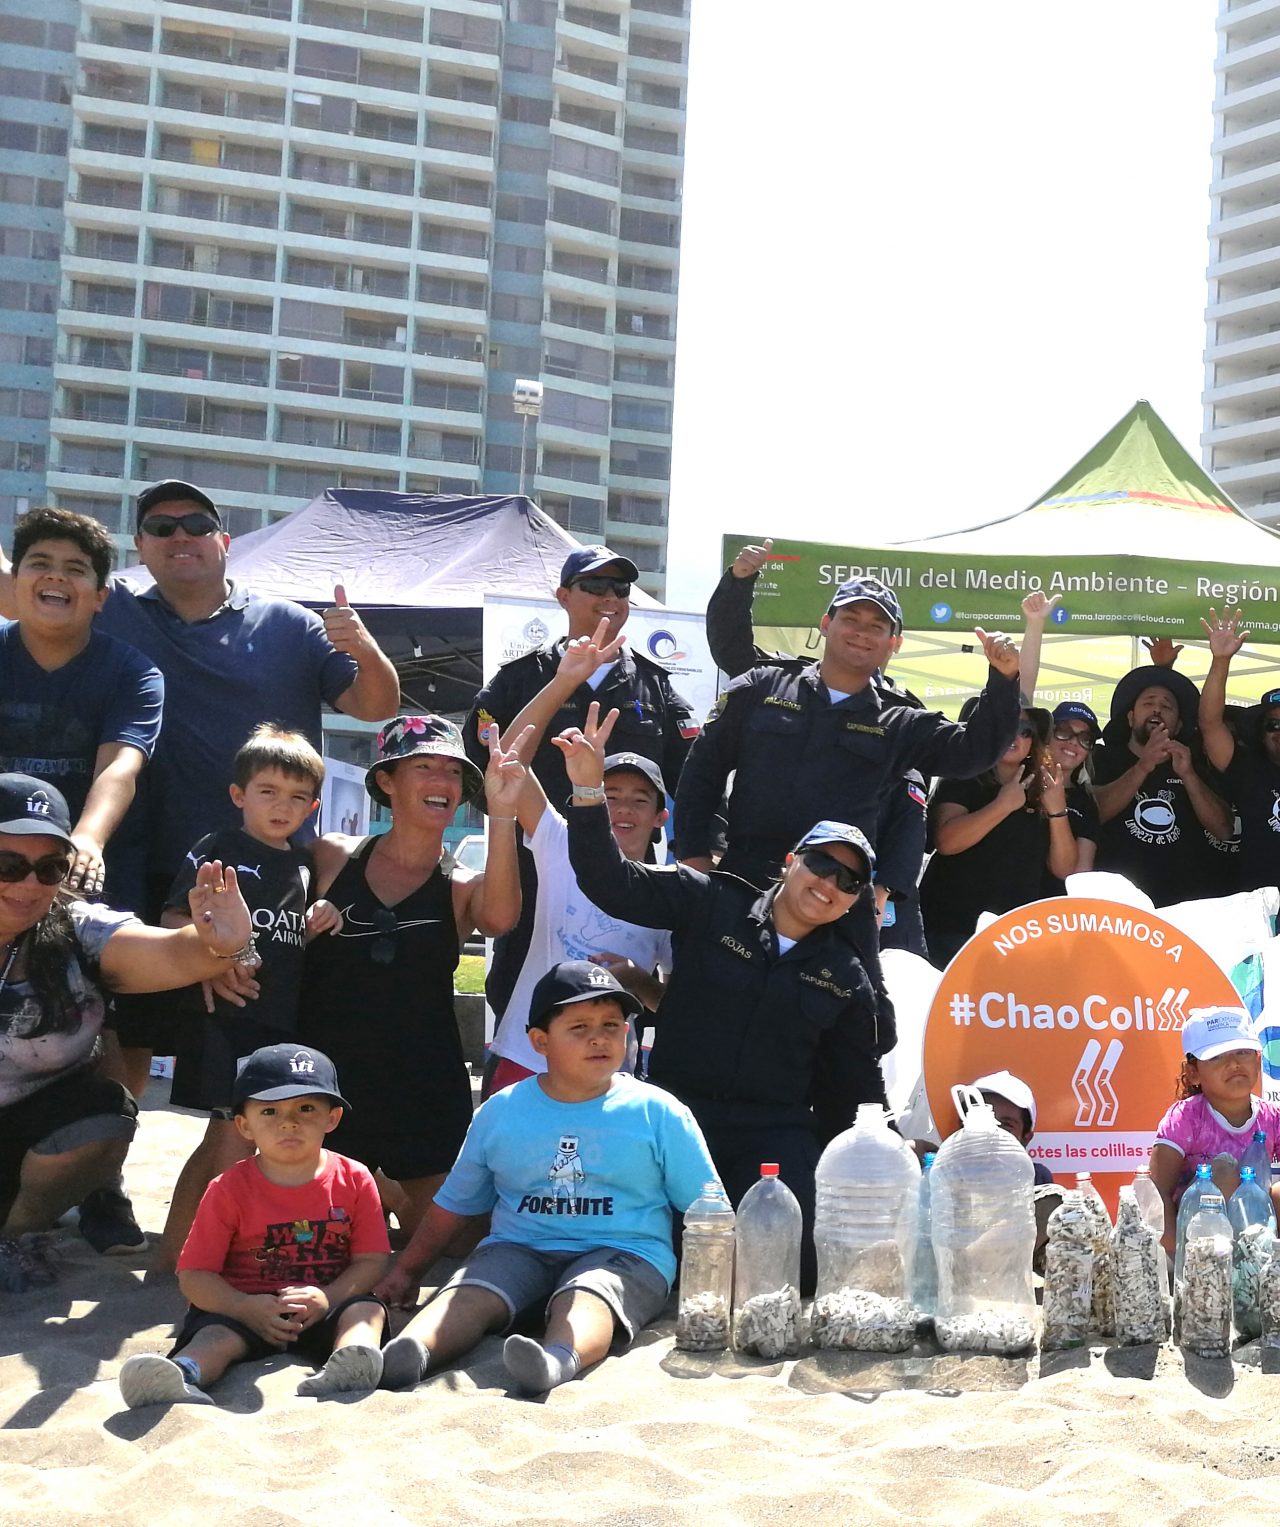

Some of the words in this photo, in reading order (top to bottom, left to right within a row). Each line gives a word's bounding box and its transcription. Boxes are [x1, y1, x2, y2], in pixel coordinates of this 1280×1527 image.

[818, 564, 911, 588] SEREMI
[919, 567, 957, 589] del
[965, 569, 1042, 591] Medio
[1050, 571, 1168, 595] Ambiente
[1196, 577, 1277, 605] Región
[251, 908, 307, 932] QATA
[720, 935, 753, 959] ROJAS
[993, 918, 1043, 956] NOS
[1046, 913, 1166, 949] SUMAMOS
[1165, 944, 1184, 963] A
[1028, 1145, 1062, 1159] otes
[1065, 1141, 1087, 1158] las
[1091, 1141, 1143, 1158] colillas
[516, 1195, 614, 1217] FORTNITE
